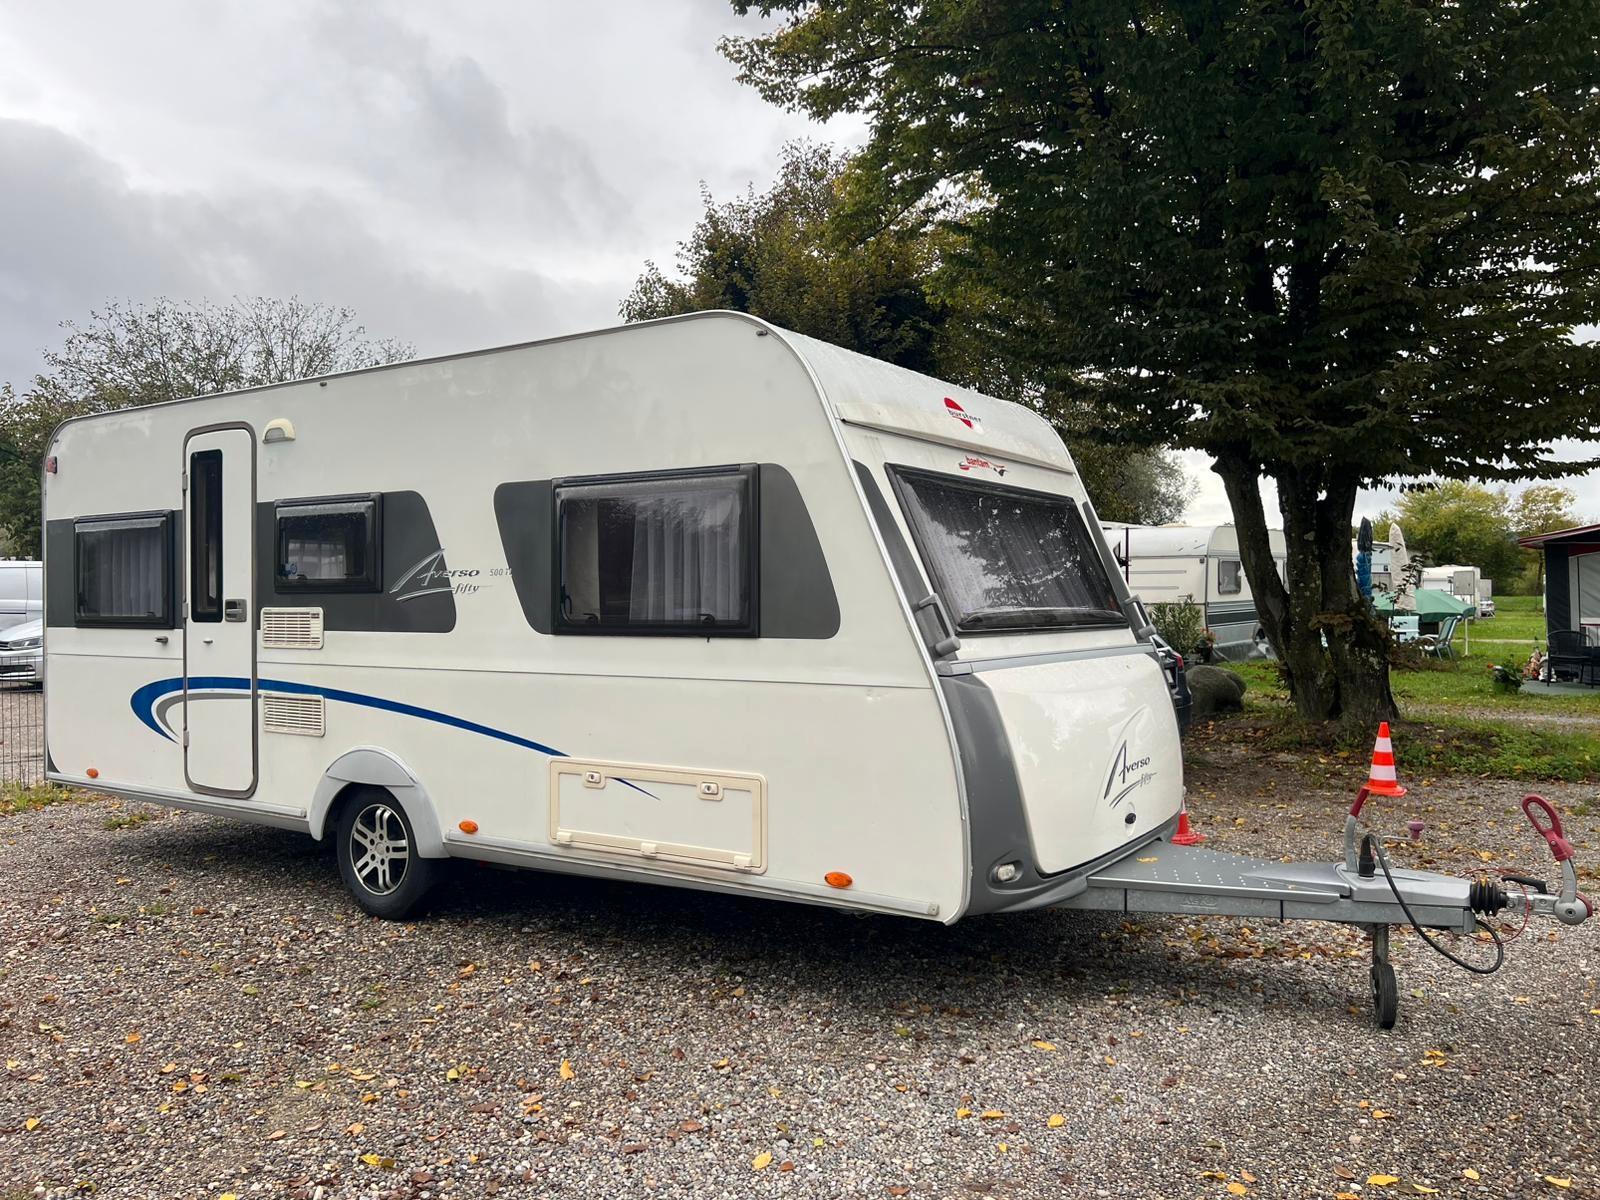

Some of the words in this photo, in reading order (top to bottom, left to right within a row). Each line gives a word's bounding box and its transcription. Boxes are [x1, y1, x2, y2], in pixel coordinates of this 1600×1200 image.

[389, 548, 480, 594] Averso
[489, 568, 504, 577] 500
[454, 583, 480, 595] fifty
[1103, 739, 1151, 800] Averso
